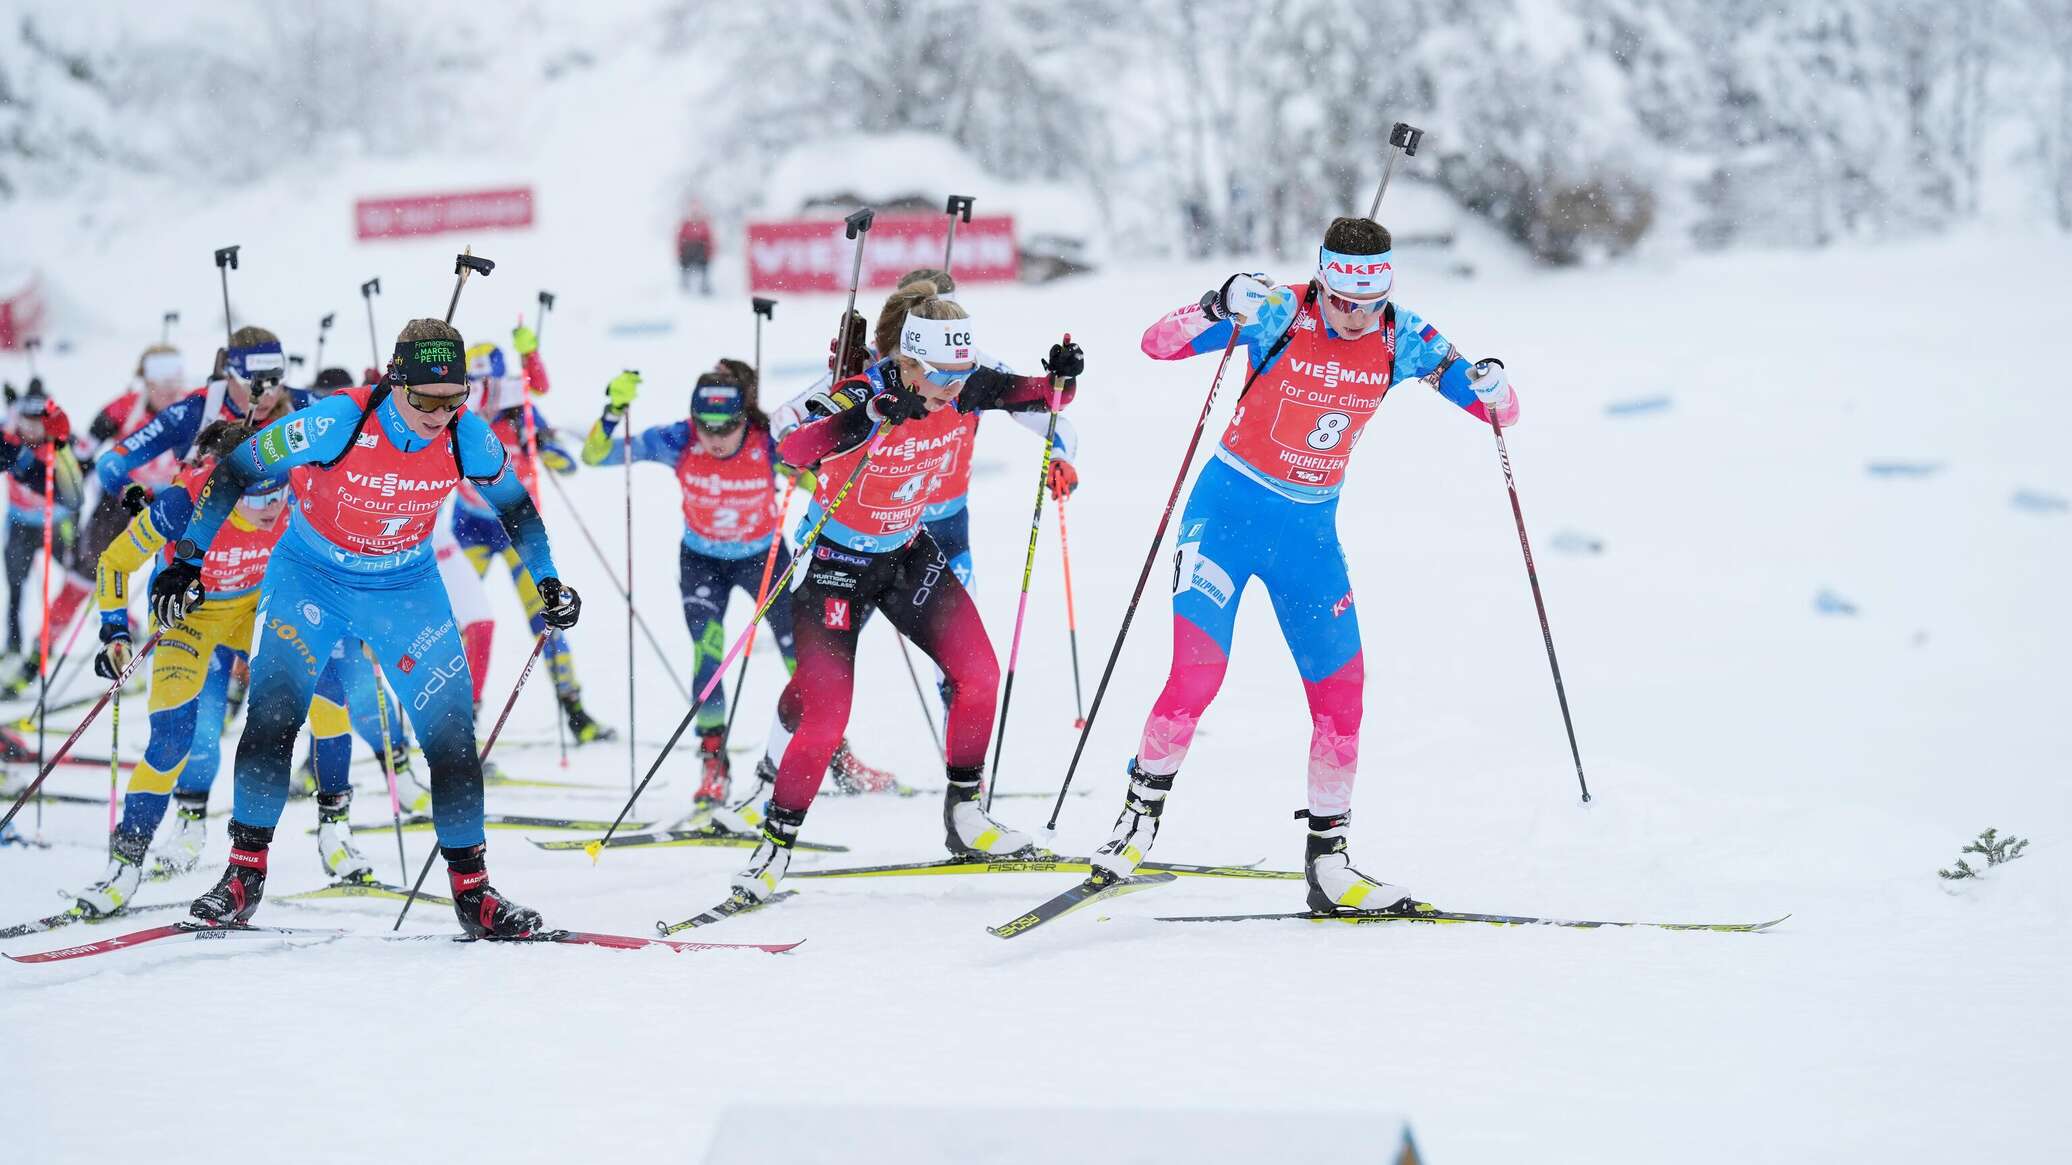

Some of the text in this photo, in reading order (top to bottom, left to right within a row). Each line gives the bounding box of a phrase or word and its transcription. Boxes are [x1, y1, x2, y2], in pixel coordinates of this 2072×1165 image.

[1326, 261, 1392, 275] AKFA
[1292, 306, 1309, 333] SWIX
[415, 340, 455, 348] Fromageries
[944, 325, 972, 347] ice
[1386, 327, 1395, 356] SWIX
[420, 347, 451, 355] MARCEL
[420, 354, 453, 363] PETITE
[1279, 379, 1305, 398] For
[1308, 391, 1336, 404] our
[123, 418, 165, 452] BKW
[1306, 412, 1351, 451] 8
[890, 464, 914, 474] our
[1279, 450, 1346, 470] HOCHFILZEN
[346, 471, 458, 497] VIESSMANN
[337, 486, 361, 505] For
[364, 500, 395, 511] our
[712, 507, 739, 528] 2
[831, 552, 866, 566] LAPUA
[1192, 573, 1226, 604] GAZPROM
[407, 625, 434, 655] CAISSE
[414, 655, 465, 711] odlo
[986, 863, 1057, 872] FISCHER
[195, 930, 227, 941] MADSHUS
